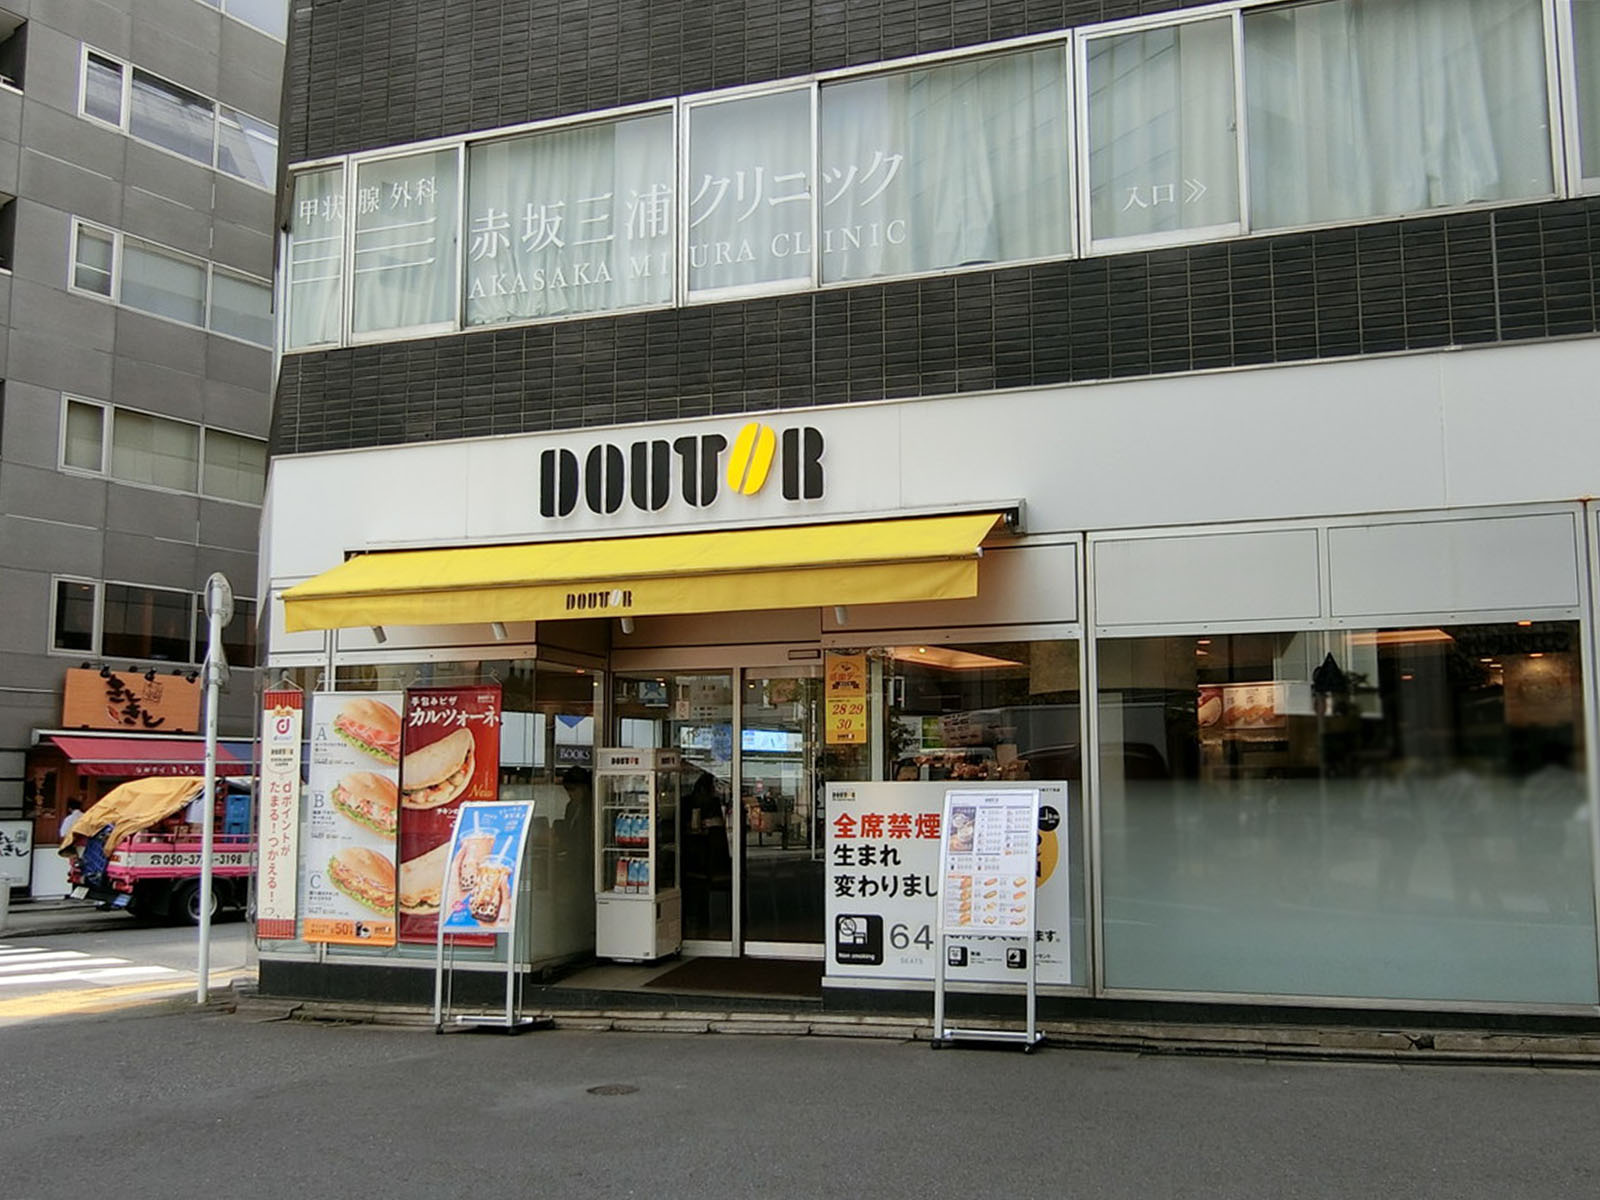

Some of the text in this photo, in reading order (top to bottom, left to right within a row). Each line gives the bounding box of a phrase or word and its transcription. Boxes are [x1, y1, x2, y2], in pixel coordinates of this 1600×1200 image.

[1122, 183, 1175, 213] 入口
[468, 260, 613, 300] AKASAKA
[771, 219, 906, 258] CLINIC
[539, 422, 824, 518] DOUTOR
[565, 589, 632, 610] DOUTOR
[408, 704, 500, 728] カルツォーネ
[832, 703, 864, 715] 28 29
[316, 727, 328, 740] A
[837, 718, 852, 729] 30
[314, 794, 325, 808] B
[833, 812, 941, 840] 全席禁煙
[162, 854, 242, 866] 050-37-3198
[833, 843, 902, 867] 生まれ
[310, 874, 322, 889] C
[890, 923, 935, 951] 64
